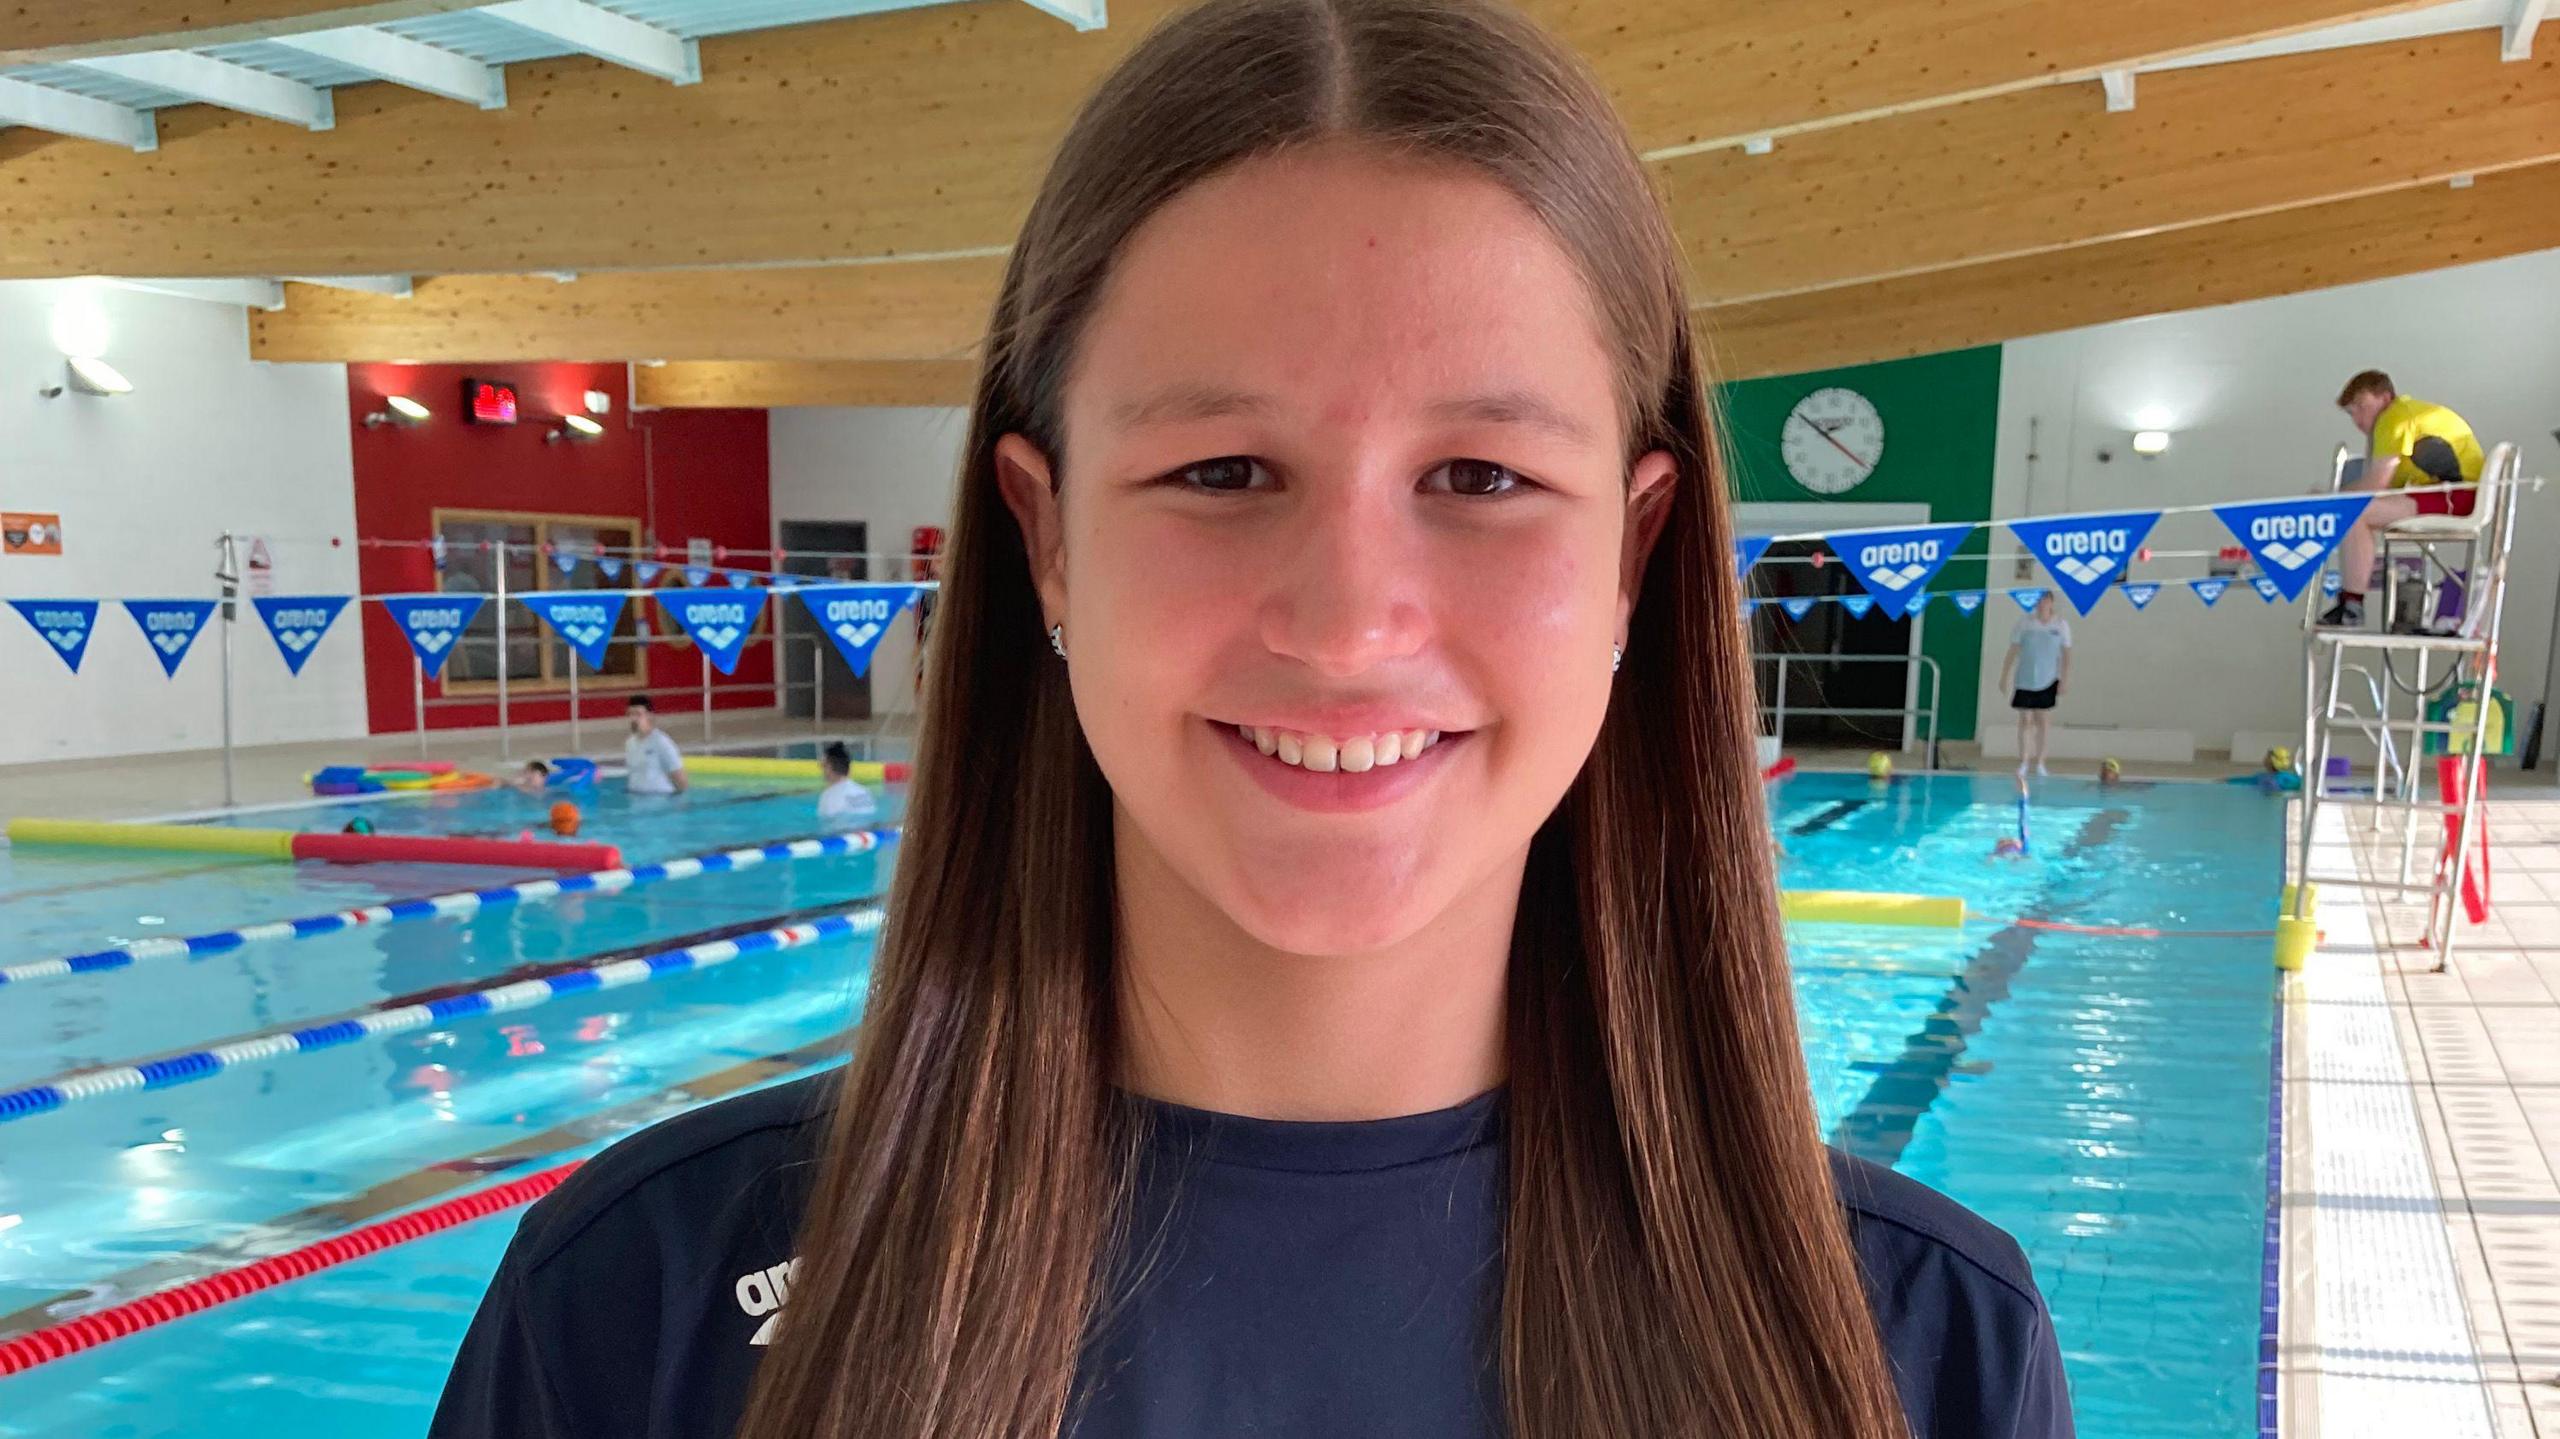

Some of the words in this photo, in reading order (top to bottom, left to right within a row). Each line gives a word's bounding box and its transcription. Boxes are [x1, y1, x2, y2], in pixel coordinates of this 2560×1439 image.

[2251, 513, 2336, 539] arena
[1860, 539, 1939, 568] arena
[2046, 529, 2126, 556] arena
[147, 612, 196, 631] arena
[274, 609, 327, 629] arena
[409, 608, 461, 629] arena
[549, 604, 607, 624] arena
[686, 603, 745, 624] arena
[827, 599, 889, 622] arena
[735, 1256, 800, 1317] ar
